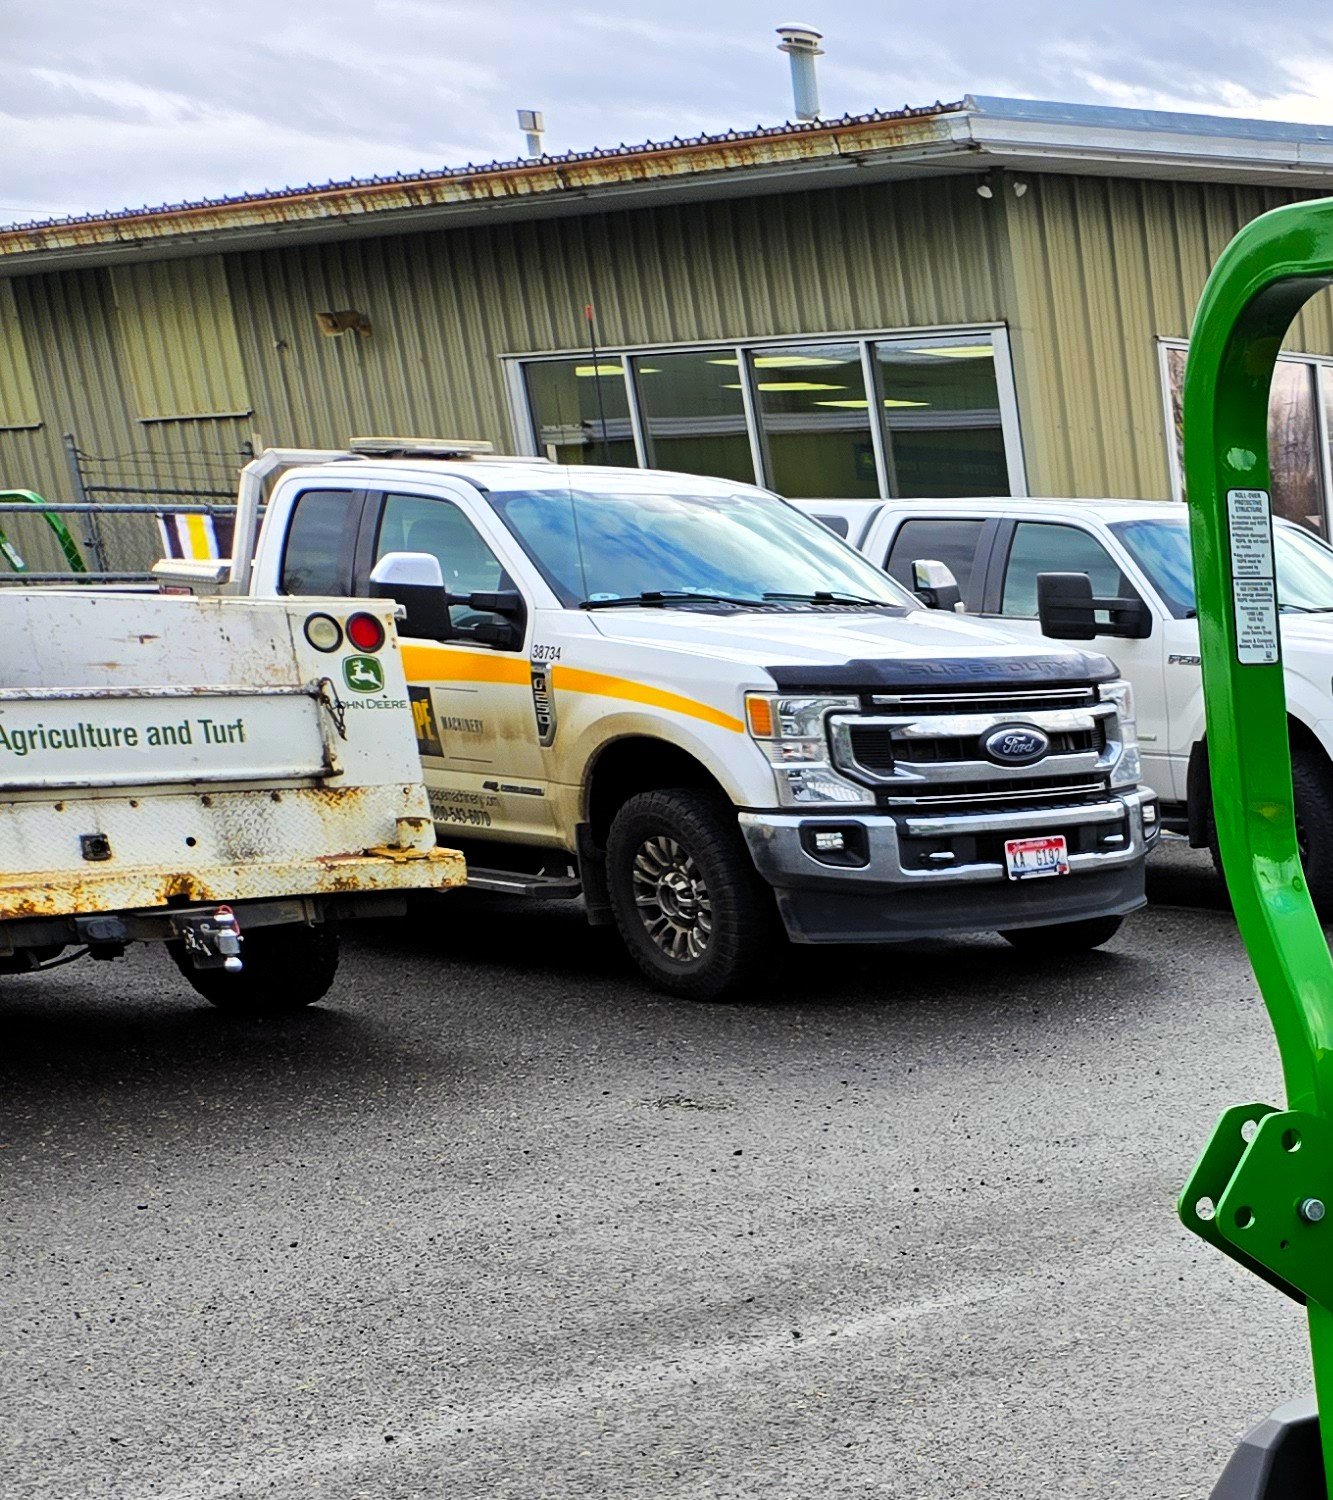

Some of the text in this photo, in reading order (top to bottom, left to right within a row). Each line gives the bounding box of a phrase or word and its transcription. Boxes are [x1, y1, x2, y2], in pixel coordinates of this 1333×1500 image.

[532, 644, 561, 661] 38734
[905, 660, 1068, 675] SUPER DUTY
[365, 698, 407, 710] DEERE
[146, 719, 192, 746] and
[197, 718, 246, 744] Turf
[440, 715, 484, 735] MACHINERY
[1002, 734, 1036, 754] Ford
